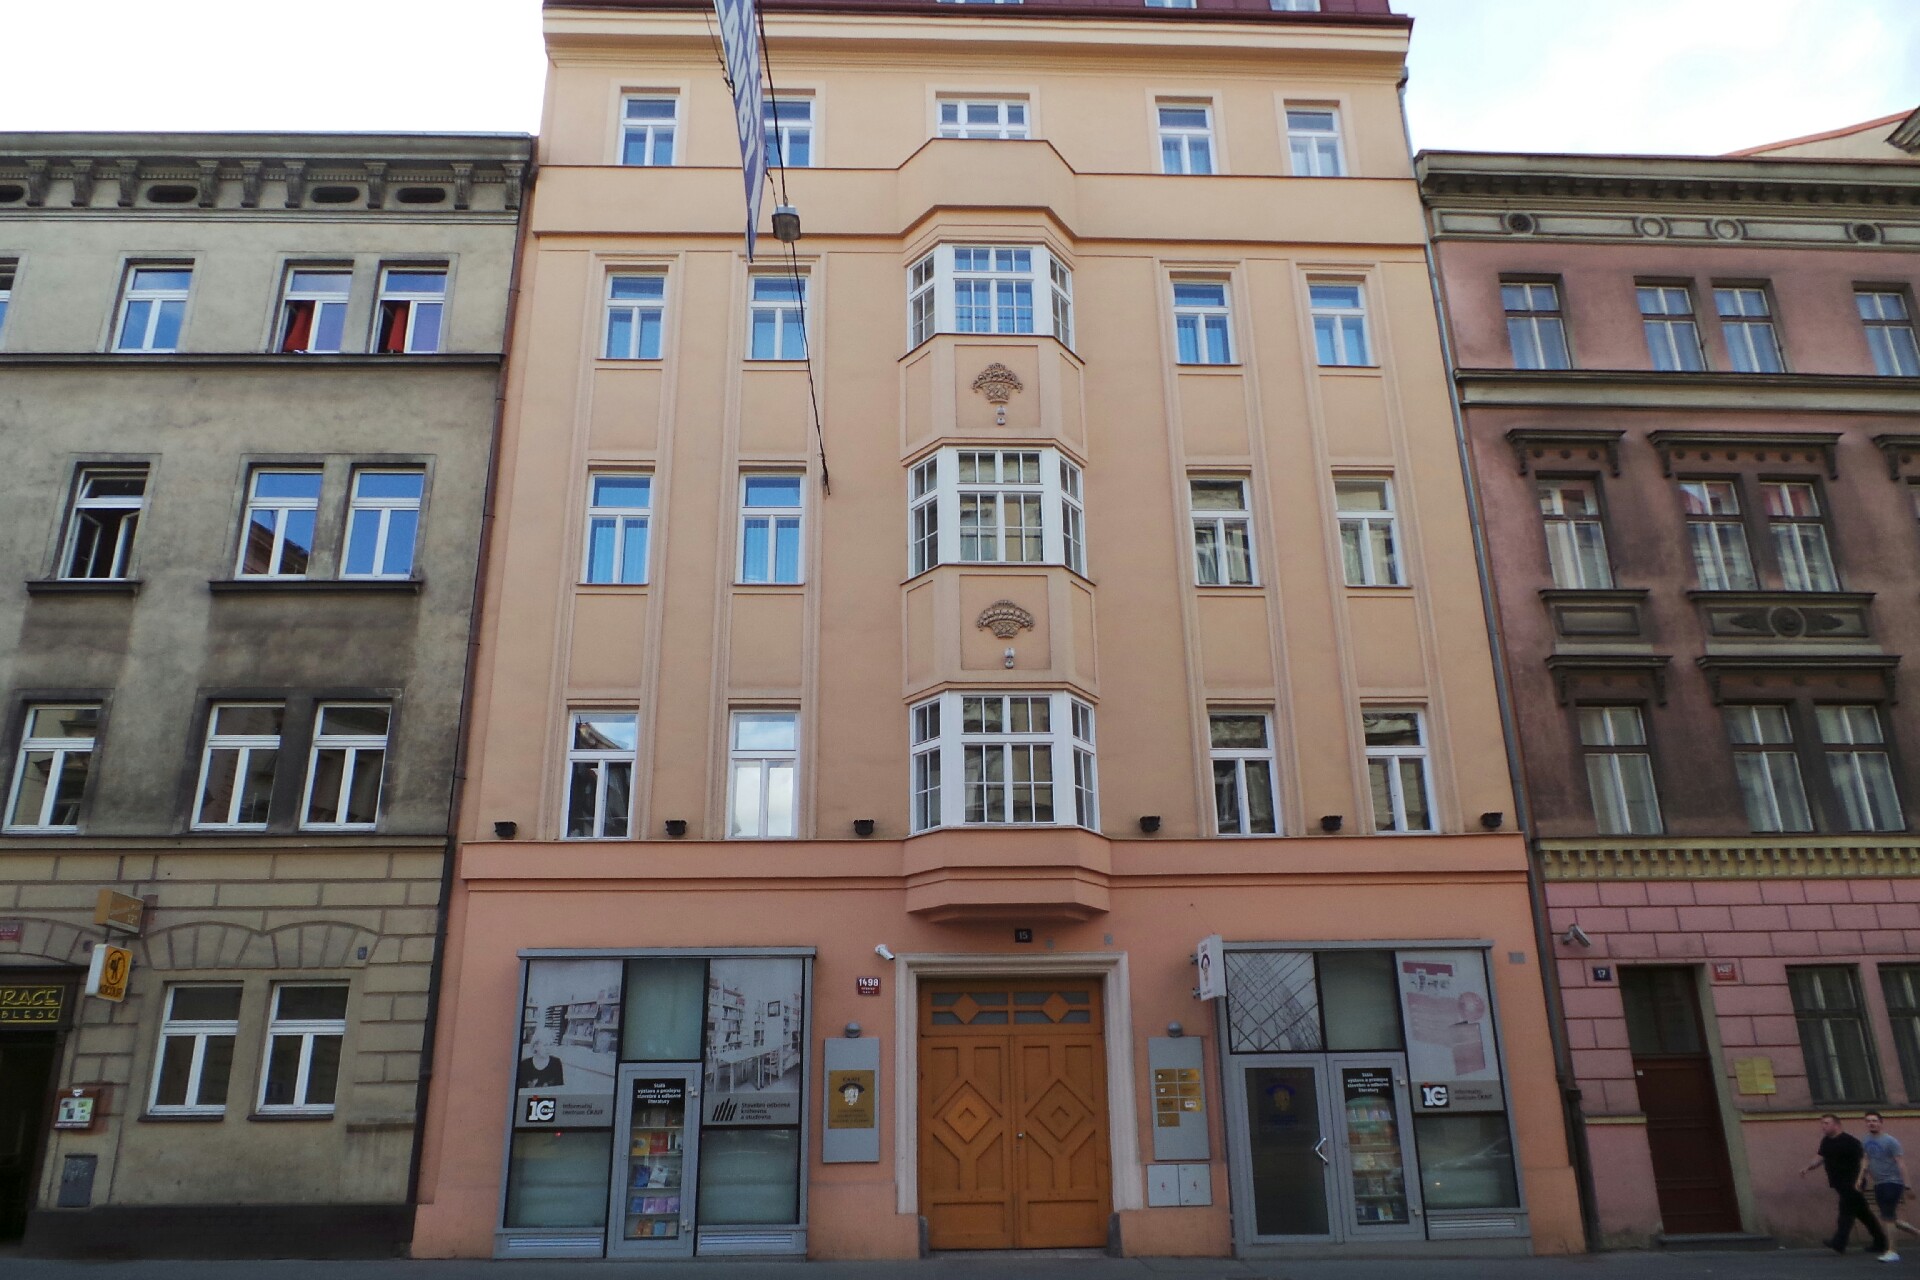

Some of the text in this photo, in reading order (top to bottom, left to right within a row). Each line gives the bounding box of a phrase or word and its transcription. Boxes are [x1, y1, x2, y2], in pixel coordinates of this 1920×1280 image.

[1019, 930, 1028, 940] 15
[1597, 969, 1606, 979] 17
[858, 978, 879, 987] 1498
